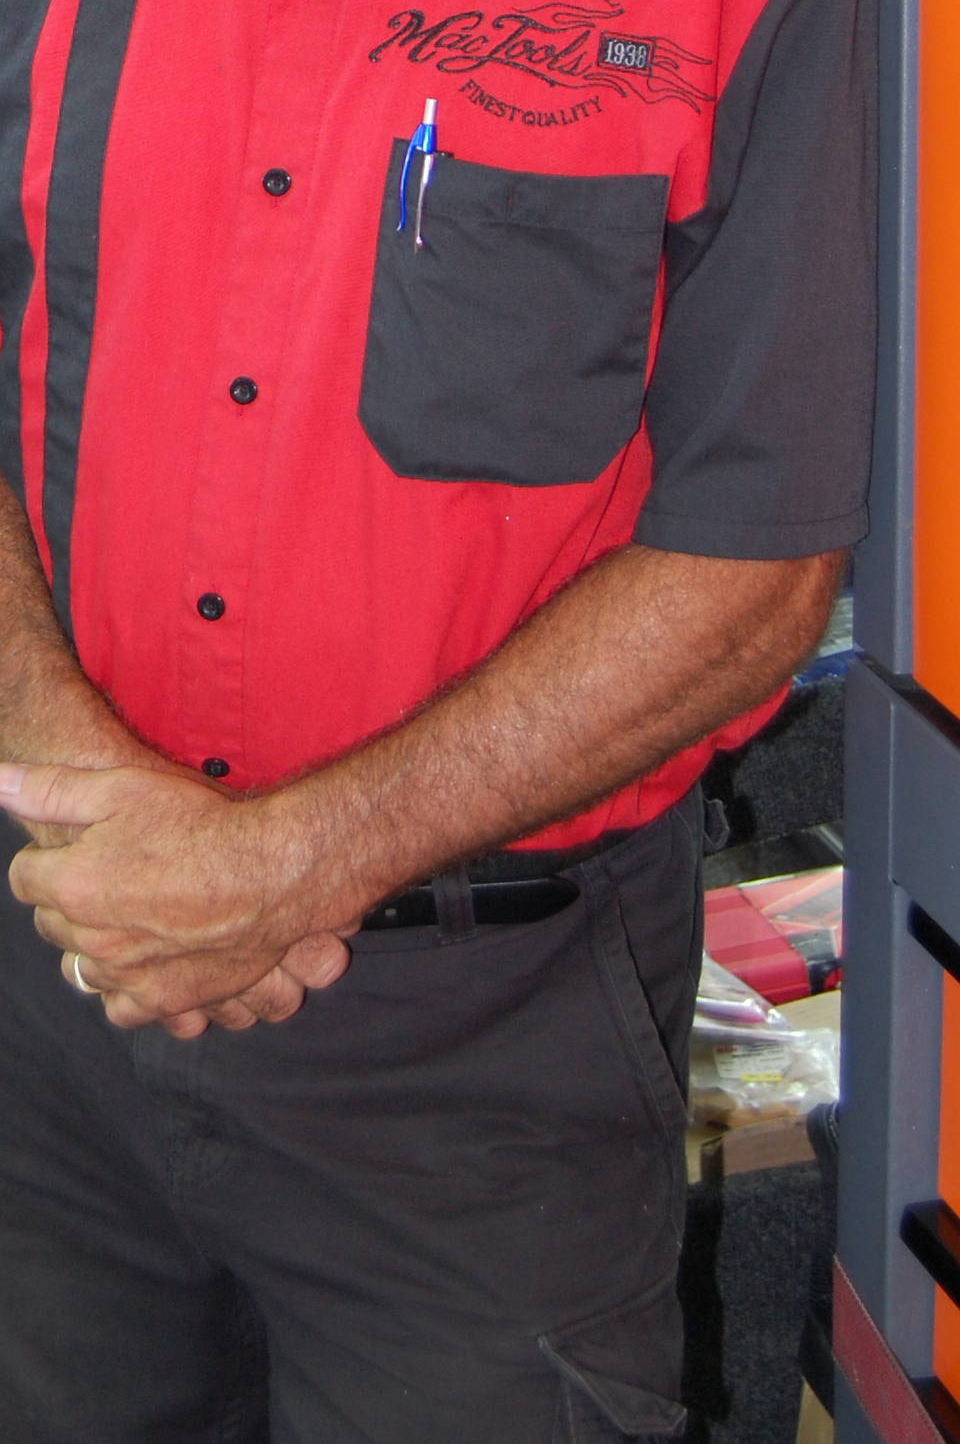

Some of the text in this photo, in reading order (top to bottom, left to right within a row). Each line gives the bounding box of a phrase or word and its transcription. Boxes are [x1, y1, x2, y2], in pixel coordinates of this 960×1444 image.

[368, 8, 592, 86] Mac Tools
[604, 40, 649, 69] 1938
[458, 77, 605, 127] FINEST QUALITY
